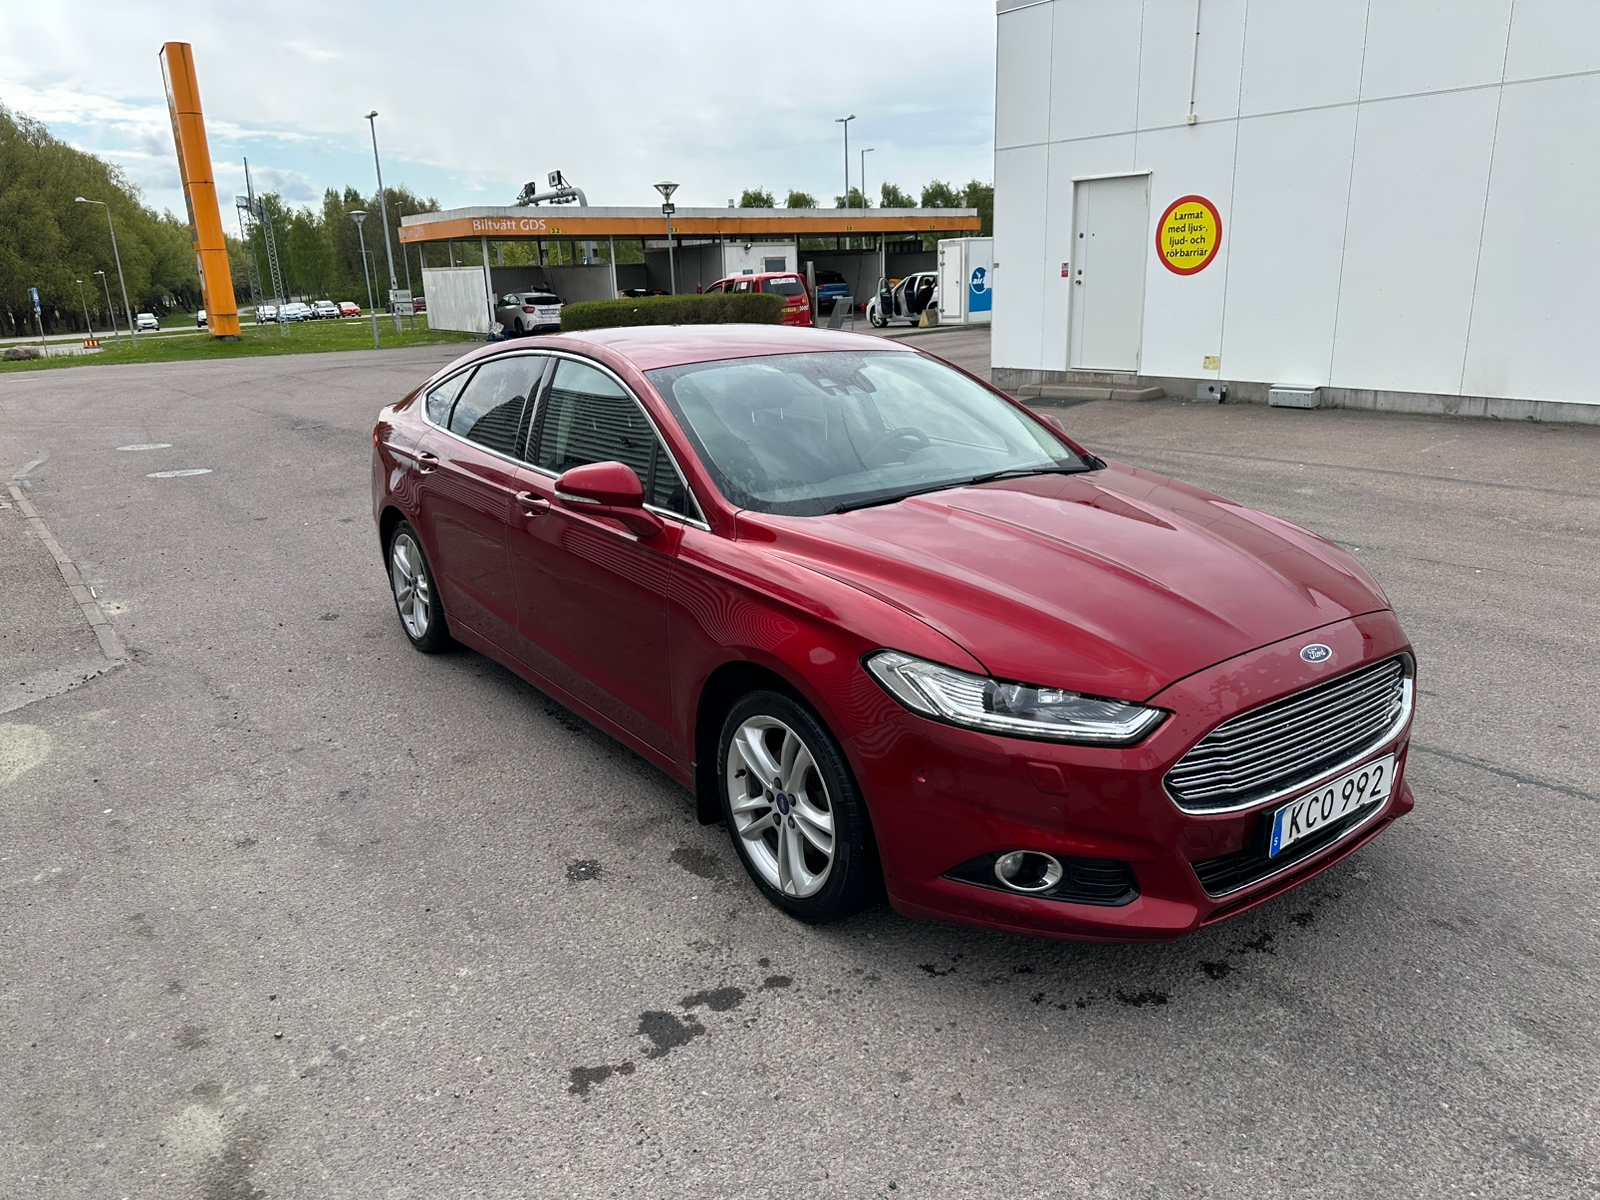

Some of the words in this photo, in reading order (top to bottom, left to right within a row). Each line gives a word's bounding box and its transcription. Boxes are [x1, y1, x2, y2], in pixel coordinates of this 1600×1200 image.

[1174, 211, 1203, 221] Larmat
[472, 218, 517, 231] Biltvätt
[519, 219, 547, 231] GDS
[1168, 223, 1186, 234] med
[1188, 223, 1208, 234] ljus-,
[1170, 236, 1188, 247] ljud-
[1190, 235, 1206, 244] och
[1166, 248, 1208, 258] rökbarriär
[1306, 647, 1327, 659] Ford
[1289, 789, 1334, 838] KCO
[1340, 765, 1383, 812] 992
[1273, 837, 1279, 846] S
